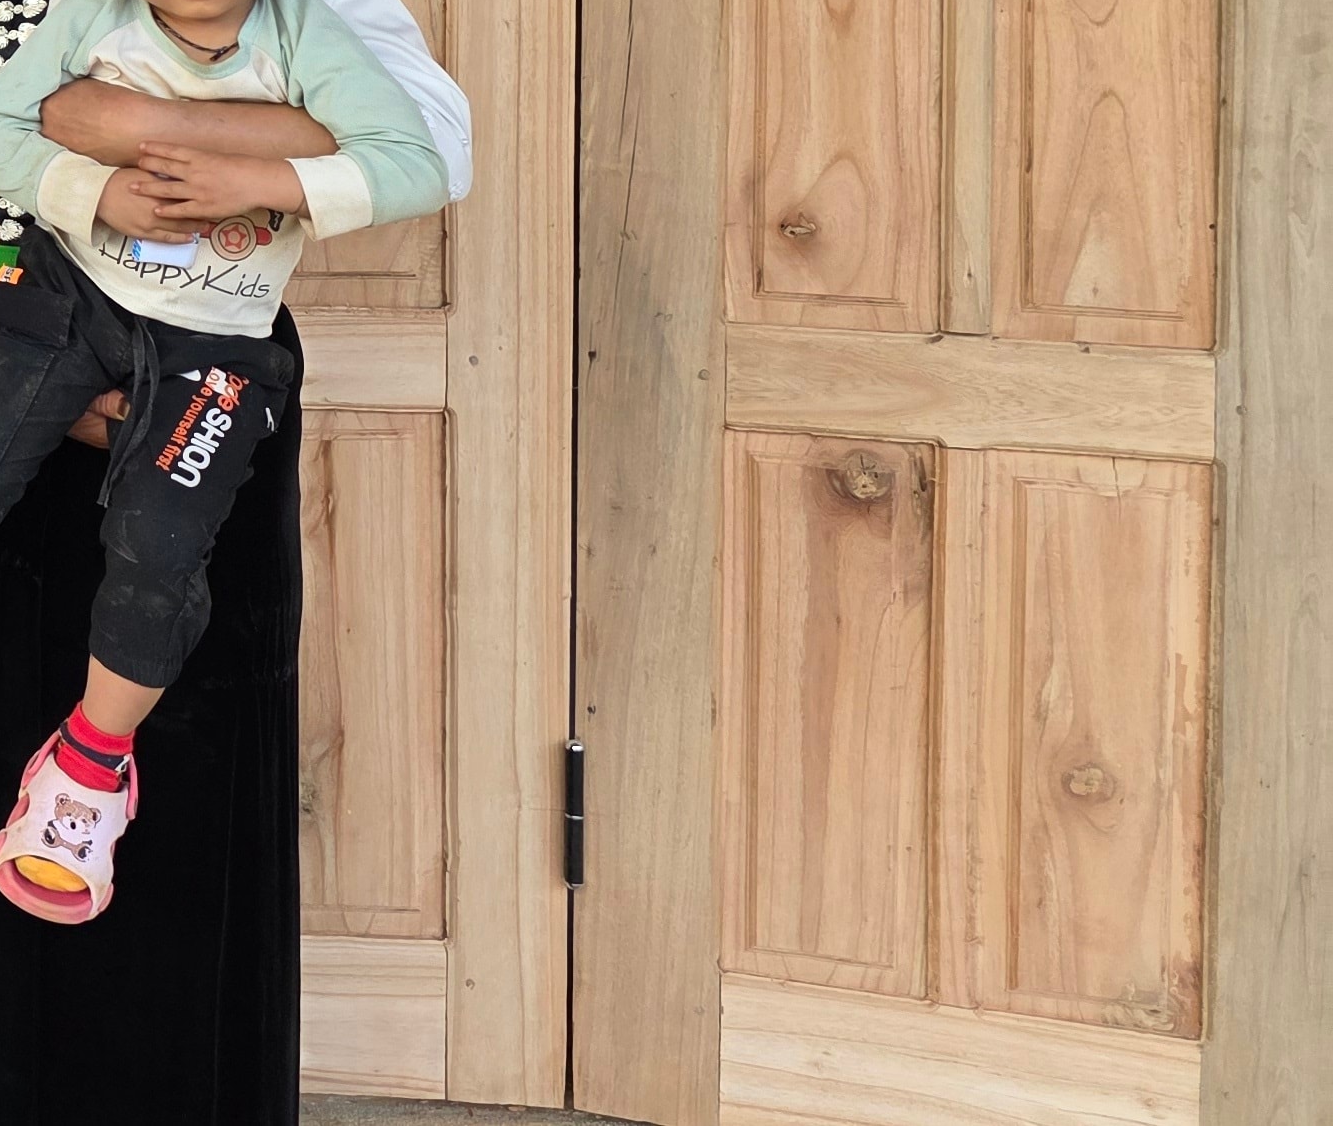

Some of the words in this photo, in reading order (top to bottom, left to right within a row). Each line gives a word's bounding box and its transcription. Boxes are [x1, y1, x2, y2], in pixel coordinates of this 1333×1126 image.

[200, 365, 221, 397] ove
[170, 394, 209, 447] yourself
[155, 443, 182, 472] first
